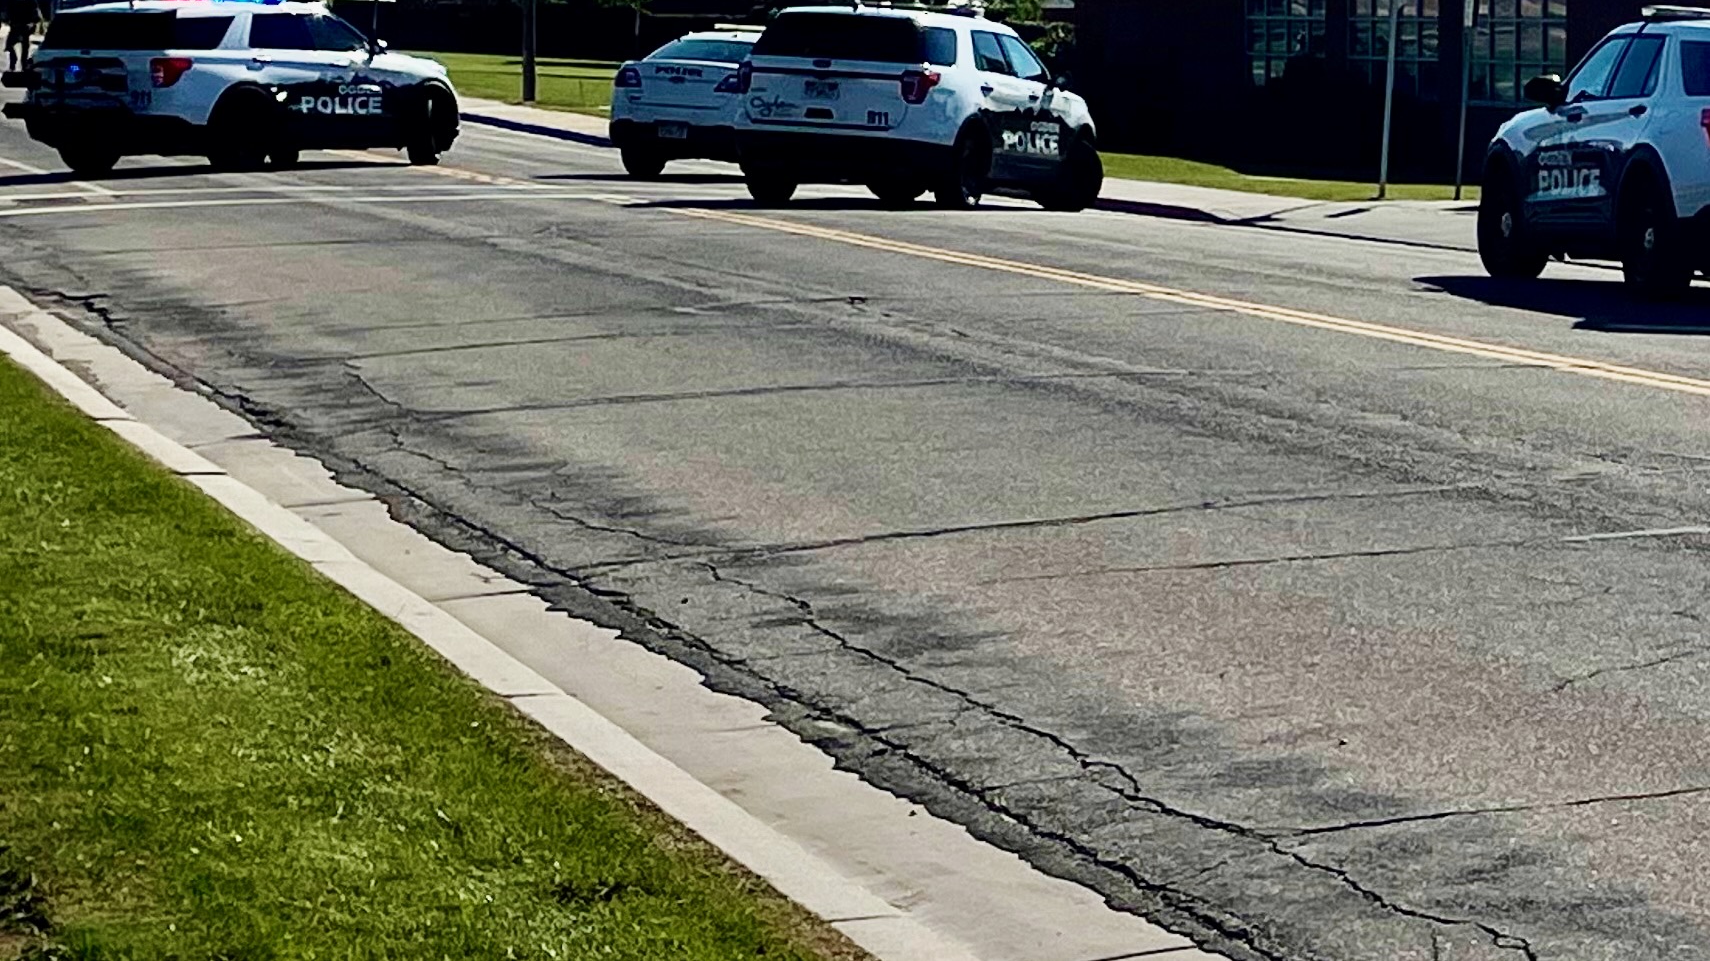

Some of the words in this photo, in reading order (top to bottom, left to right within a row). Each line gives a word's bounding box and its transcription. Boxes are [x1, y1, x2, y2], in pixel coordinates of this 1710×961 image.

[655, 66, 704, 78] POLICE
[300, 96, 383, 115] POLICE
[1001, 130, 1060, 155] POLICE
[1537, 168, 1602, 195] POLICE
